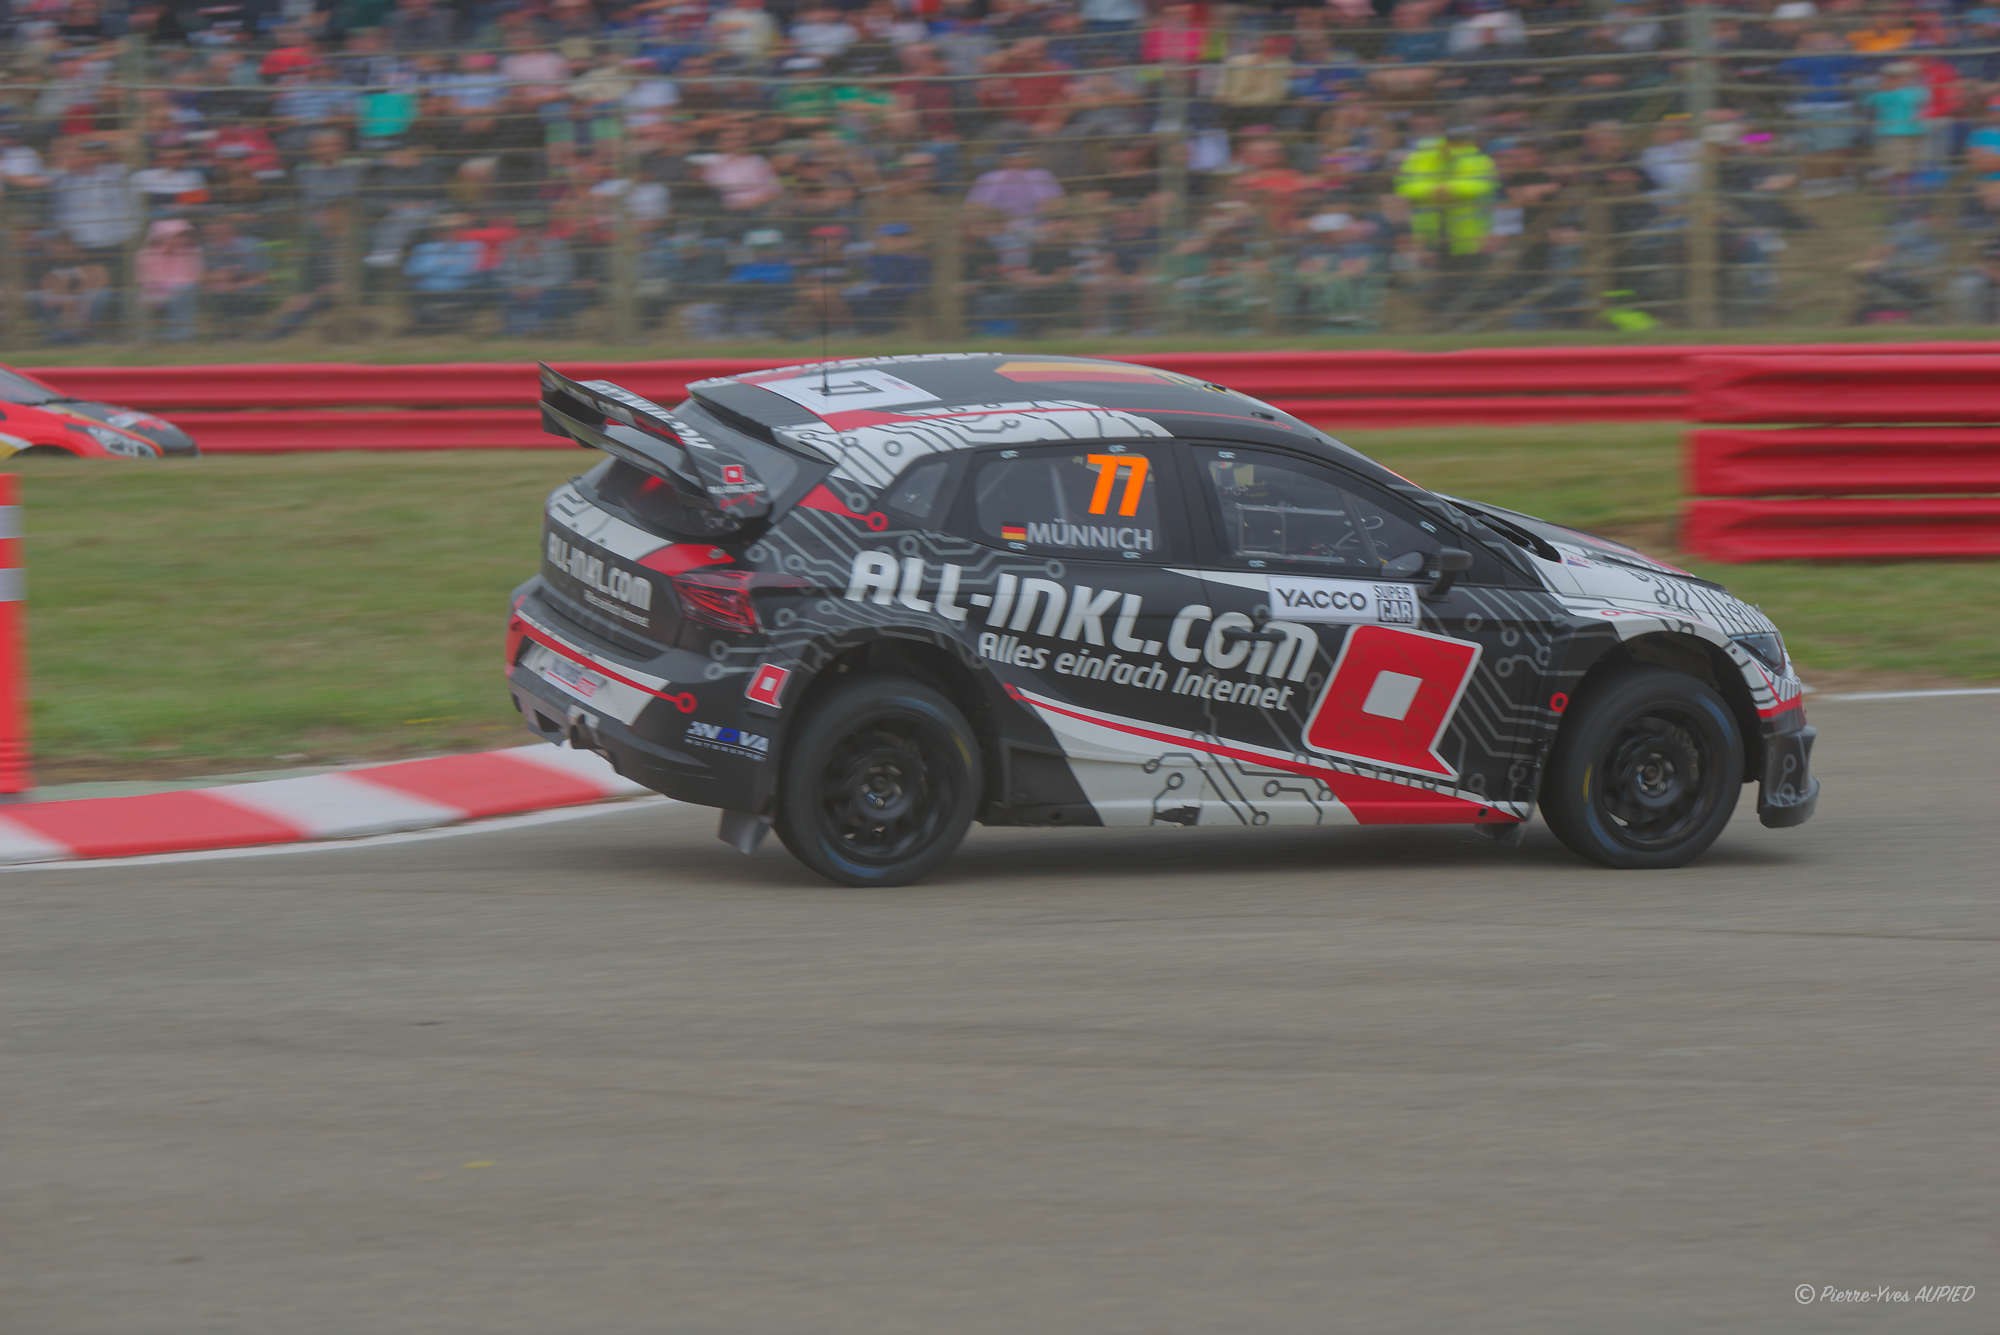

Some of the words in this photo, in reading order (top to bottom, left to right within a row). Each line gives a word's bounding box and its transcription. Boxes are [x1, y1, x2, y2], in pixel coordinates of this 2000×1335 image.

[1087, 453, 1149, 517] 77
[1026, 518, 1153, 550] MÜNNICH
[1276, 588, 1367, 610] YACCO
[1381, 600, 1413, 622] CAR
[978, 631, 1050, 669] Alles
[1054, 650, 1168, 691] einfach
[1172, 667, 1294, 711] Internet
